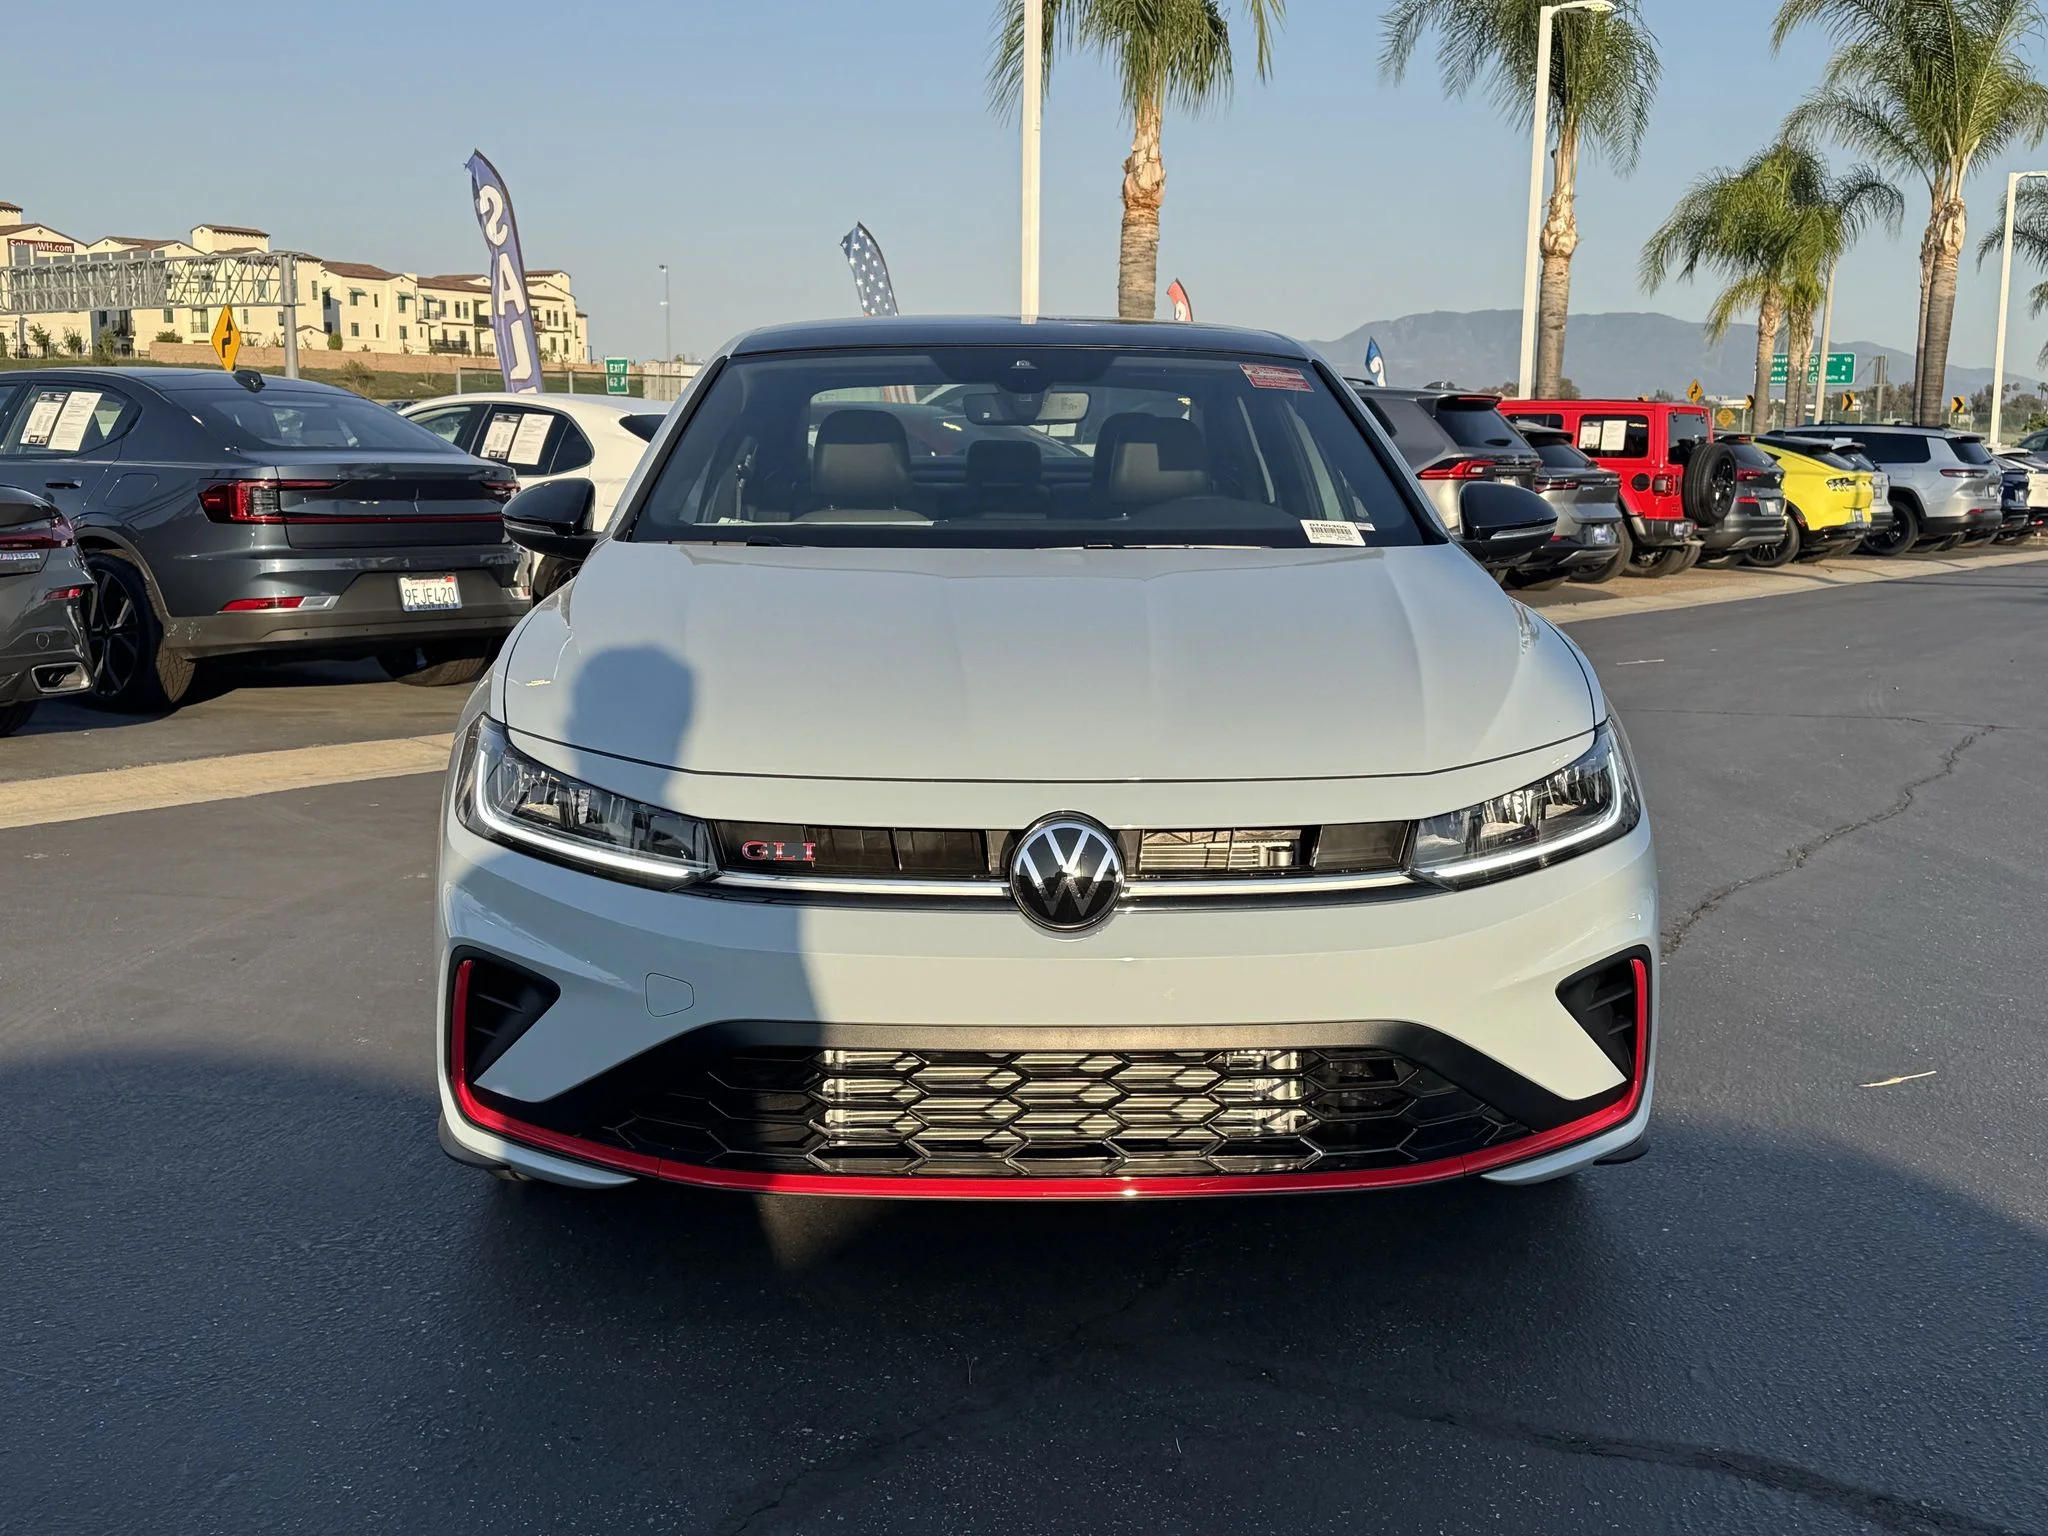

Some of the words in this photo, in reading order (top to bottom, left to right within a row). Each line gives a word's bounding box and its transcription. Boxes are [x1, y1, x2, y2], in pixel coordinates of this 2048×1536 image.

[609, 363, 625, 373] EXIT
[404, 586, 456, 606] 9EJE420
[741, 841, 816, 861] GLI
[1016, 822, 1120, 917] VW
